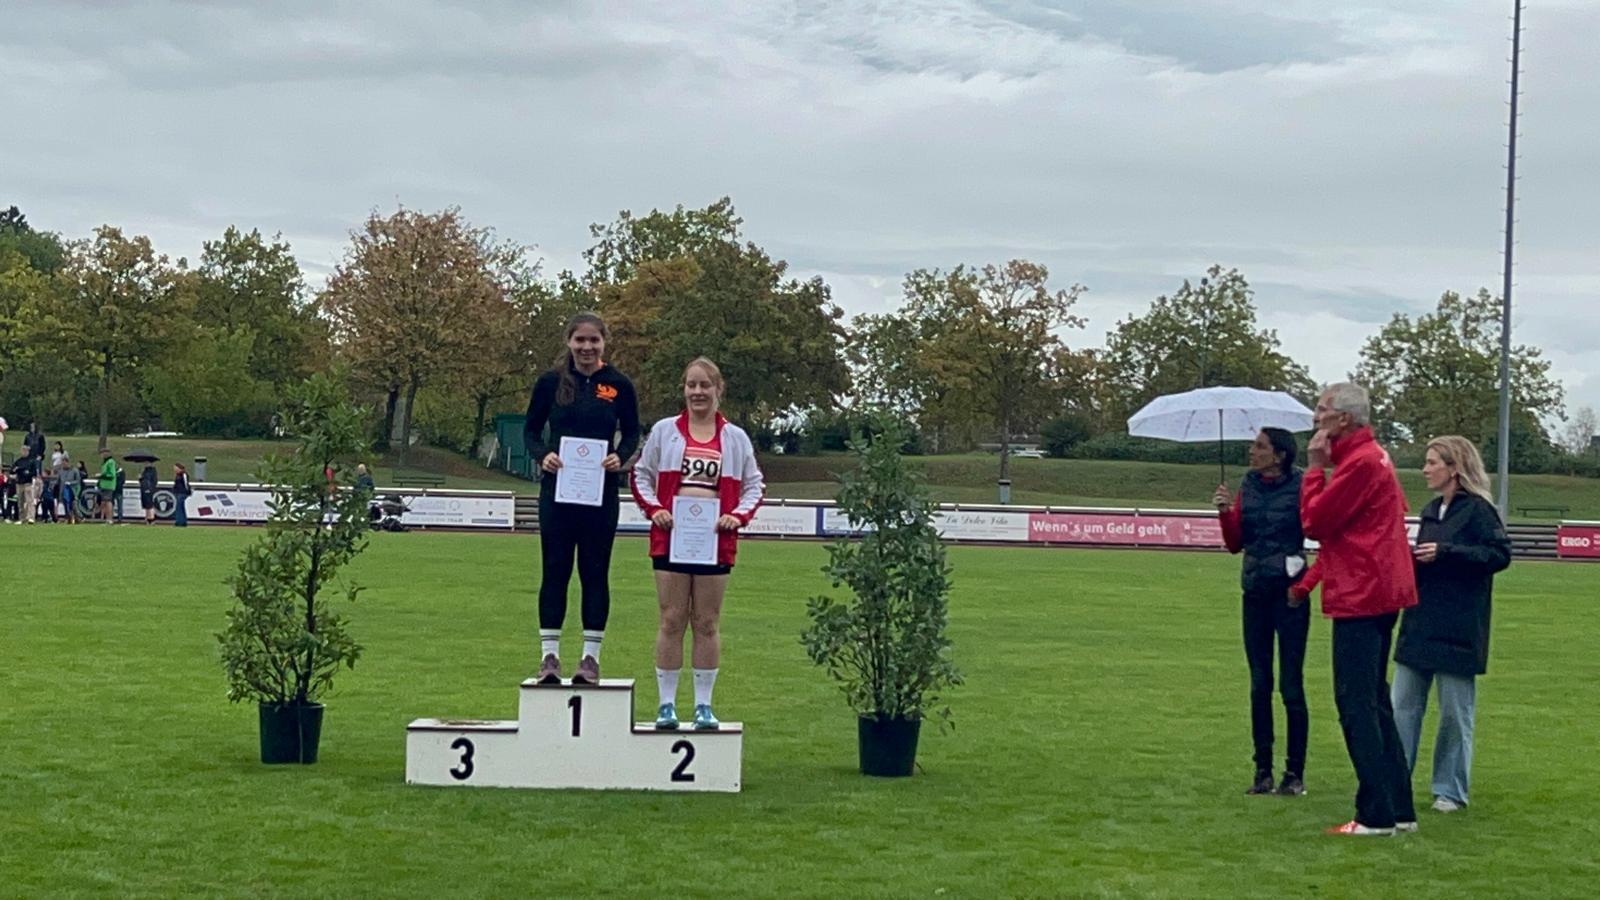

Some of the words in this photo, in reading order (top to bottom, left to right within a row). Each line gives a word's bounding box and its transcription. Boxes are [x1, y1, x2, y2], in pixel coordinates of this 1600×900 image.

[1083, 523, 1103, 534] um
[1106, 522, 1135, 535] Geld
[1137, 523, 1167, 538] geht
[1561, 536, 1590, 547] ERGO
[567, 695, 582, 737] 1
[450, 737, 475, 780] 3
[670, 740, 695, 782] 2
